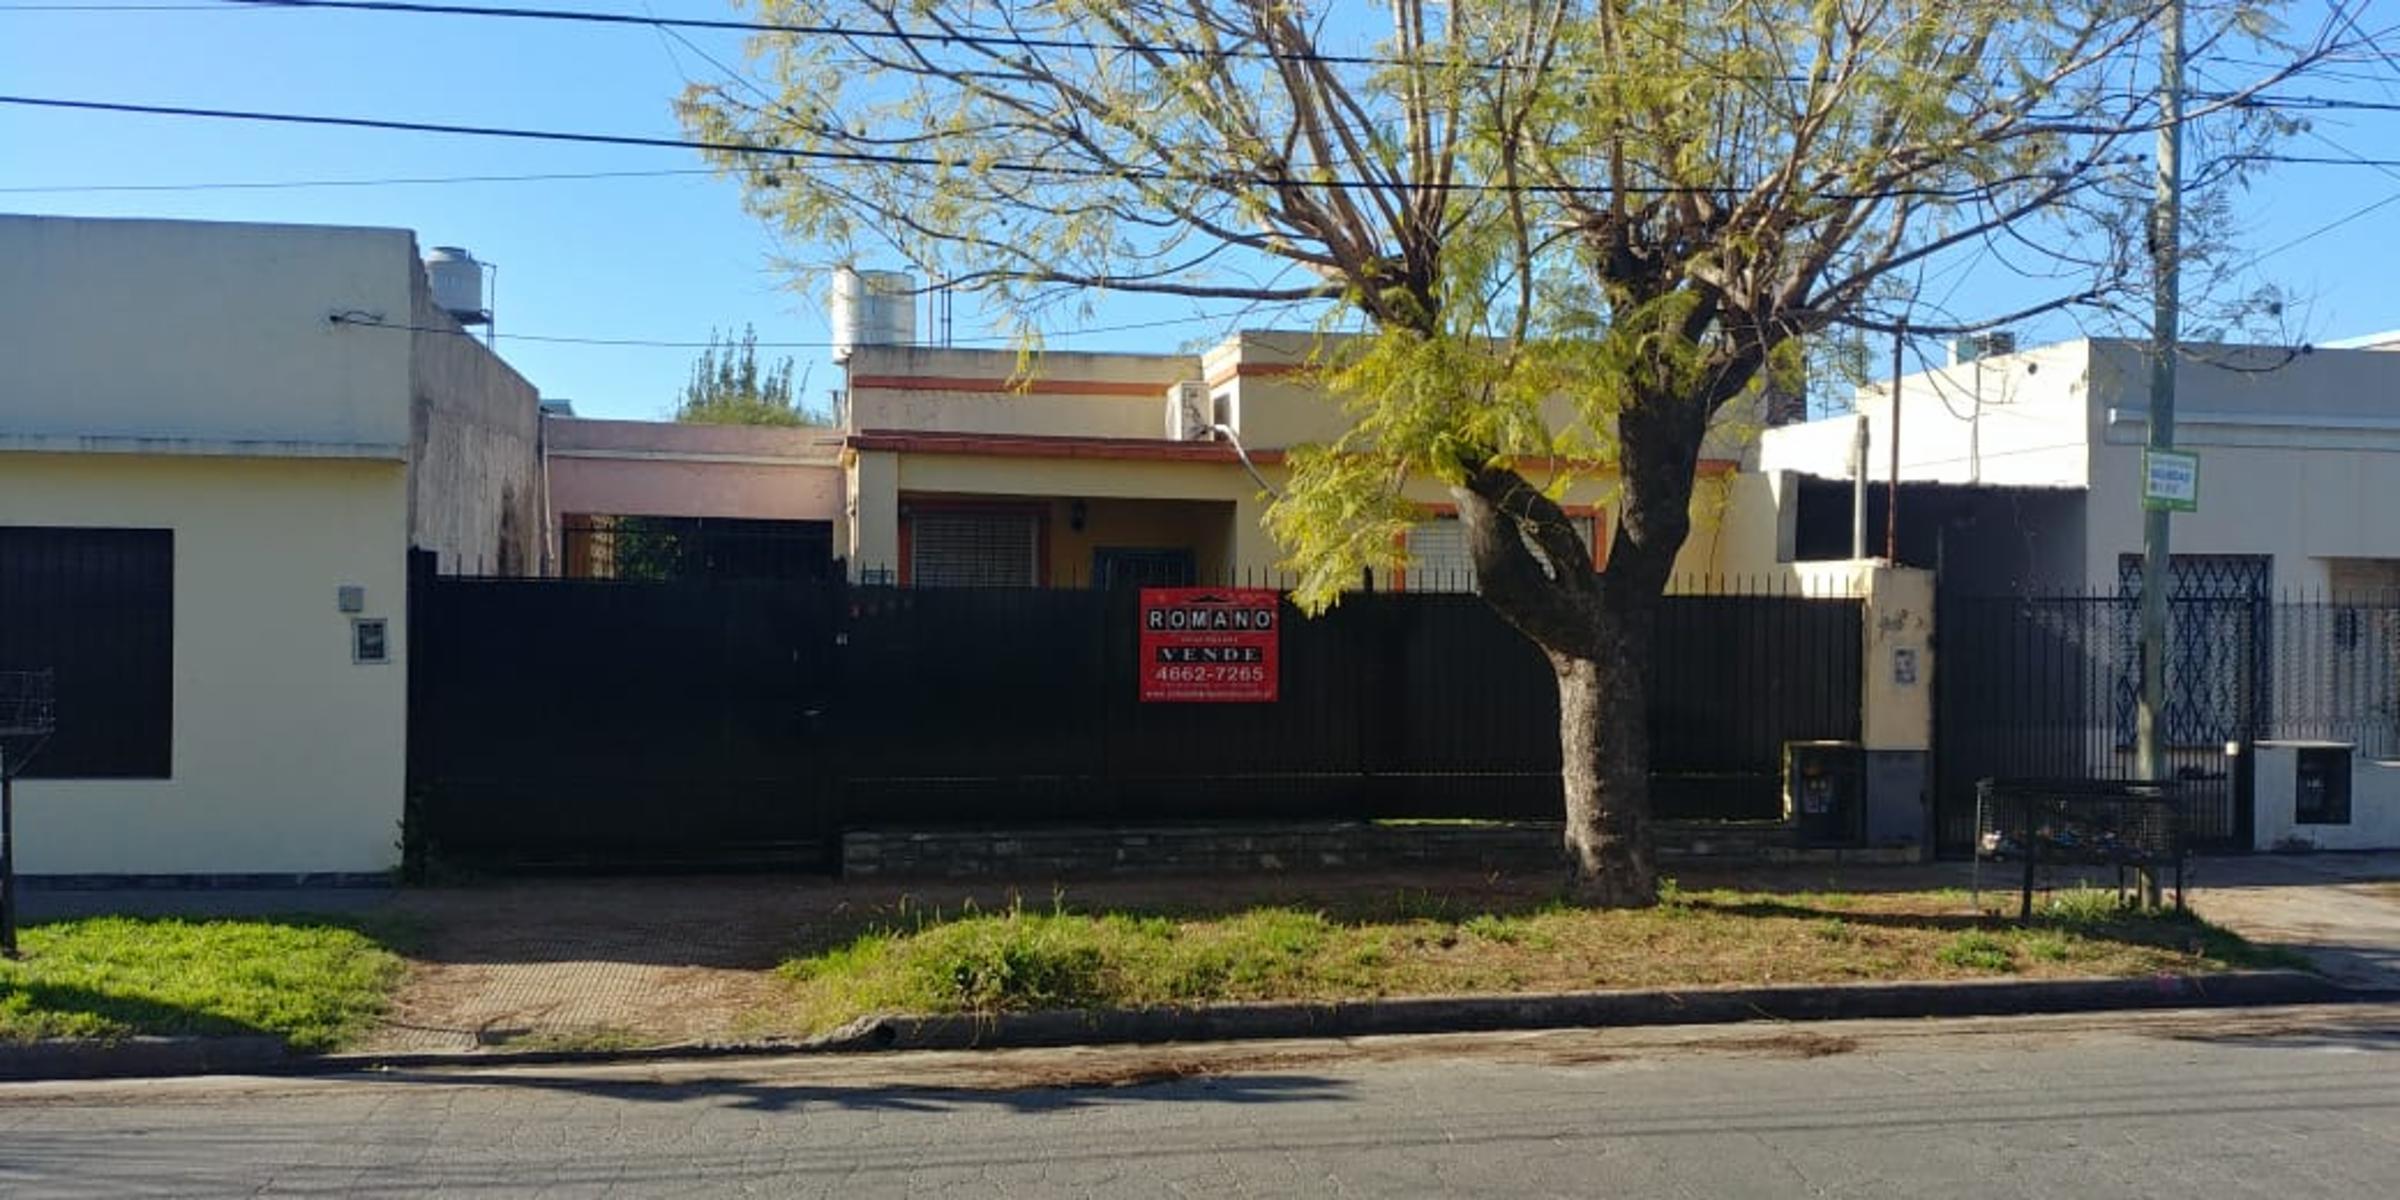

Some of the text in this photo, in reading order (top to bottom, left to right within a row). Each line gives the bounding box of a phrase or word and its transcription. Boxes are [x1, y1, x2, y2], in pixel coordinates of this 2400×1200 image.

[1149, 611, 1270, 628] ROMANO
[1161, 647, 1259, 661] VENDE
[1155, 666, 1264, 682] 4662-7265
